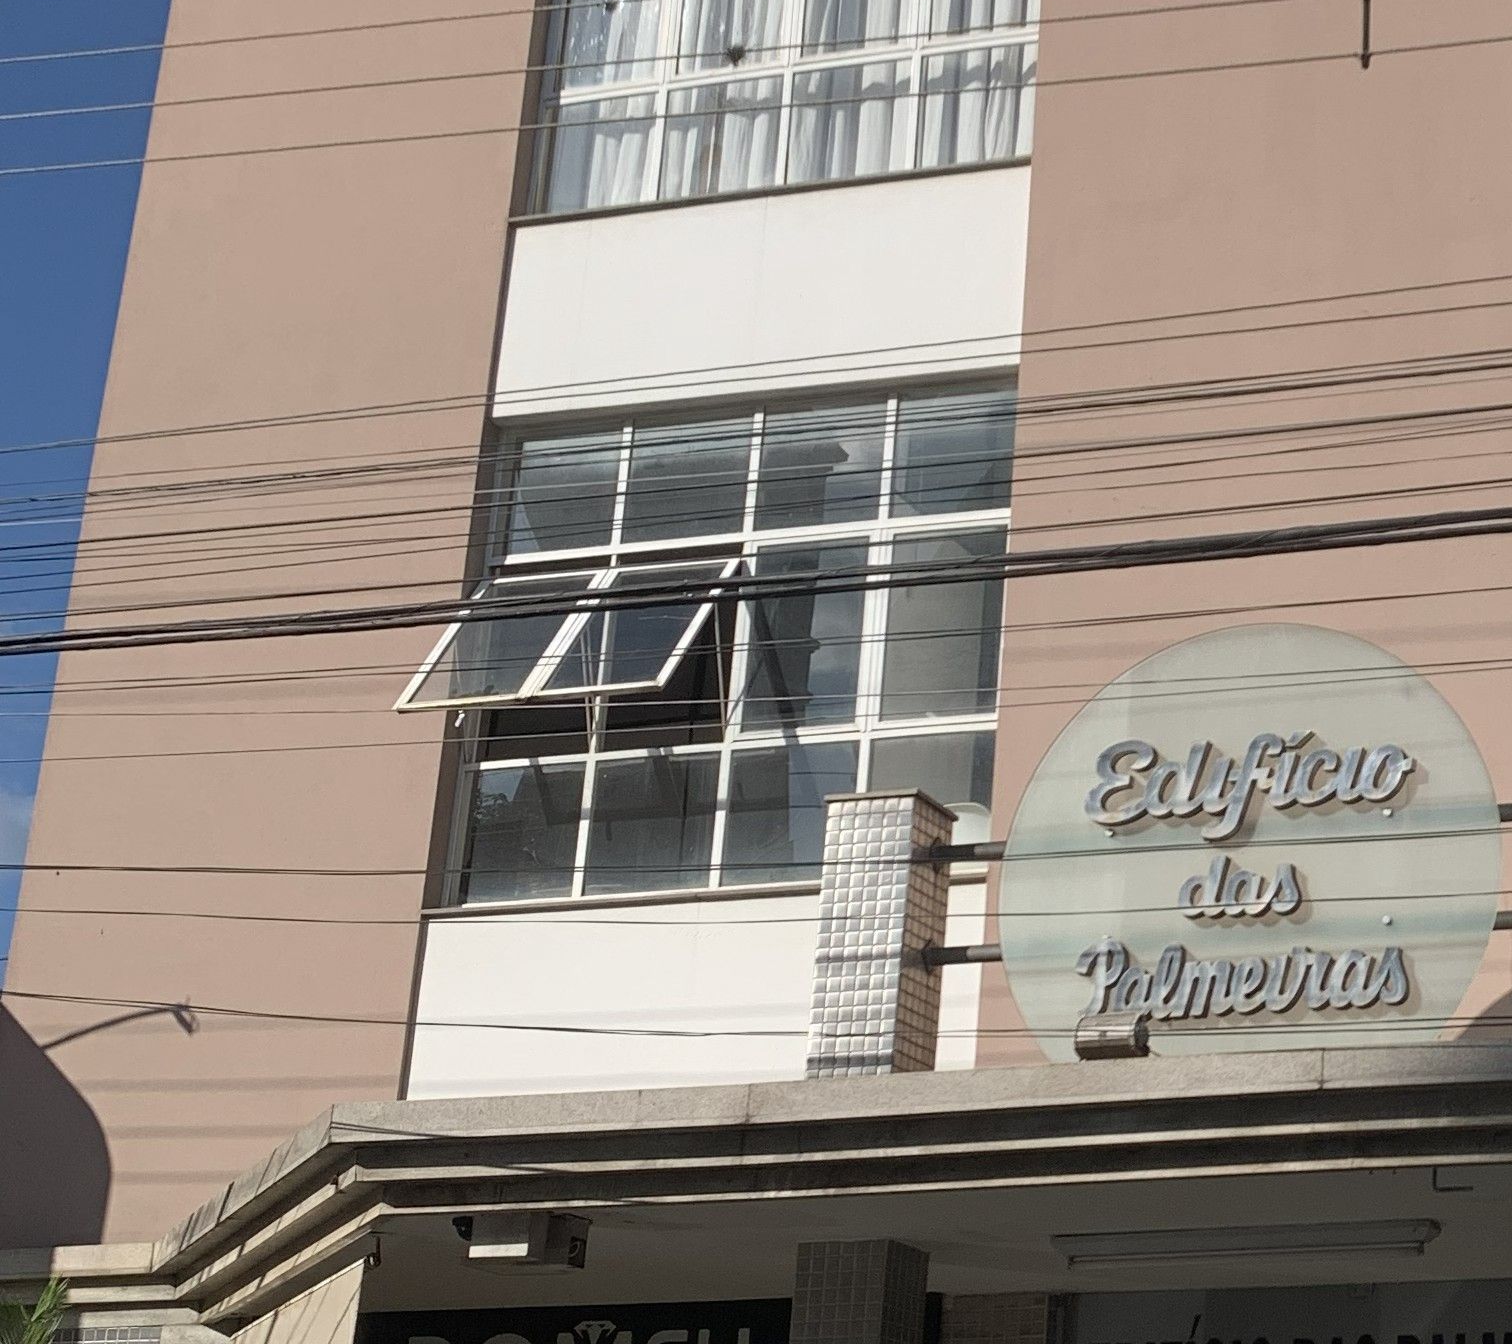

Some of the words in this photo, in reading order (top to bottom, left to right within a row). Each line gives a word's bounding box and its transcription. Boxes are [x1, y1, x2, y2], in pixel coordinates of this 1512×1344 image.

[1085, 730, 1418, 842] Edifício
[1178, 855, 1304, 919] das
[1075, 938, 1412, 1022] Palmeiras
